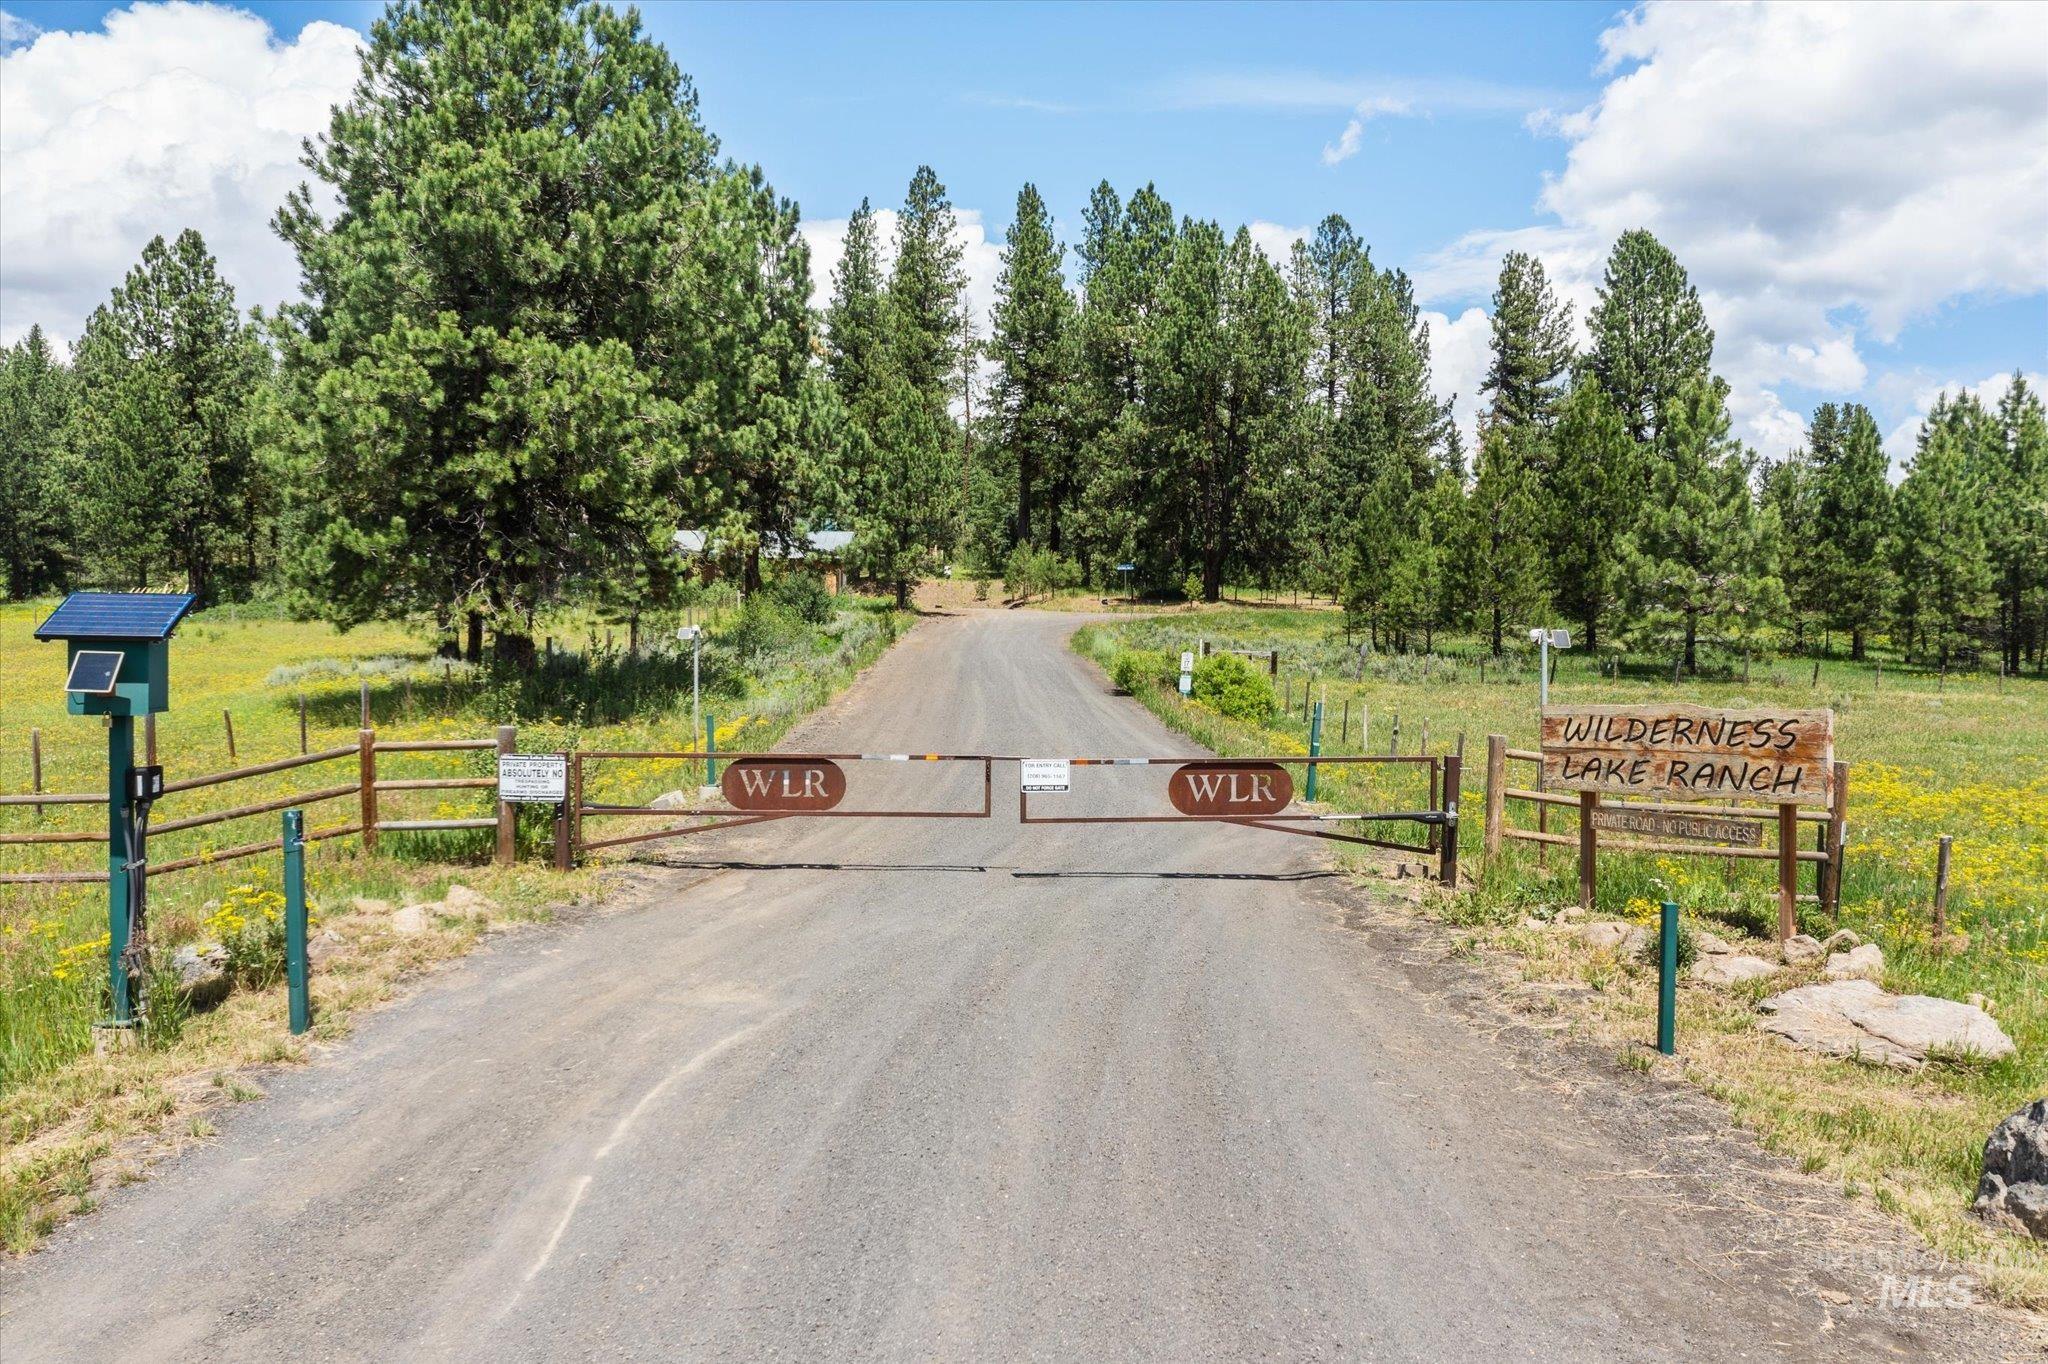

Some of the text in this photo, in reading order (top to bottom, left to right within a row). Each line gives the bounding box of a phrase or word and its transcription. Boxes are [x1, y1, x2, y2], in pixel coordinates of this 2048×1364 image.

[1563, 715, 1801, 750] WILDERNESS
[502, 769, 563, 778] ABSOLUTELY NO
[529, 761, 563, 769] PROPERTY
[1562, 756, 1803, 794] LAKE RANCH
[738, 769, 829, 798] WLR
[1185, 773, 1277, 803] WLR
[1591, 812, 1627, 827] PRIVATE
[1629, 816, 1655, 831] ROAD
[1662, 820, 1677, 834] NO
[1678, 822, 1714, 838] PUBLIC
[1715, 825, 1756, 842] ACCESS
